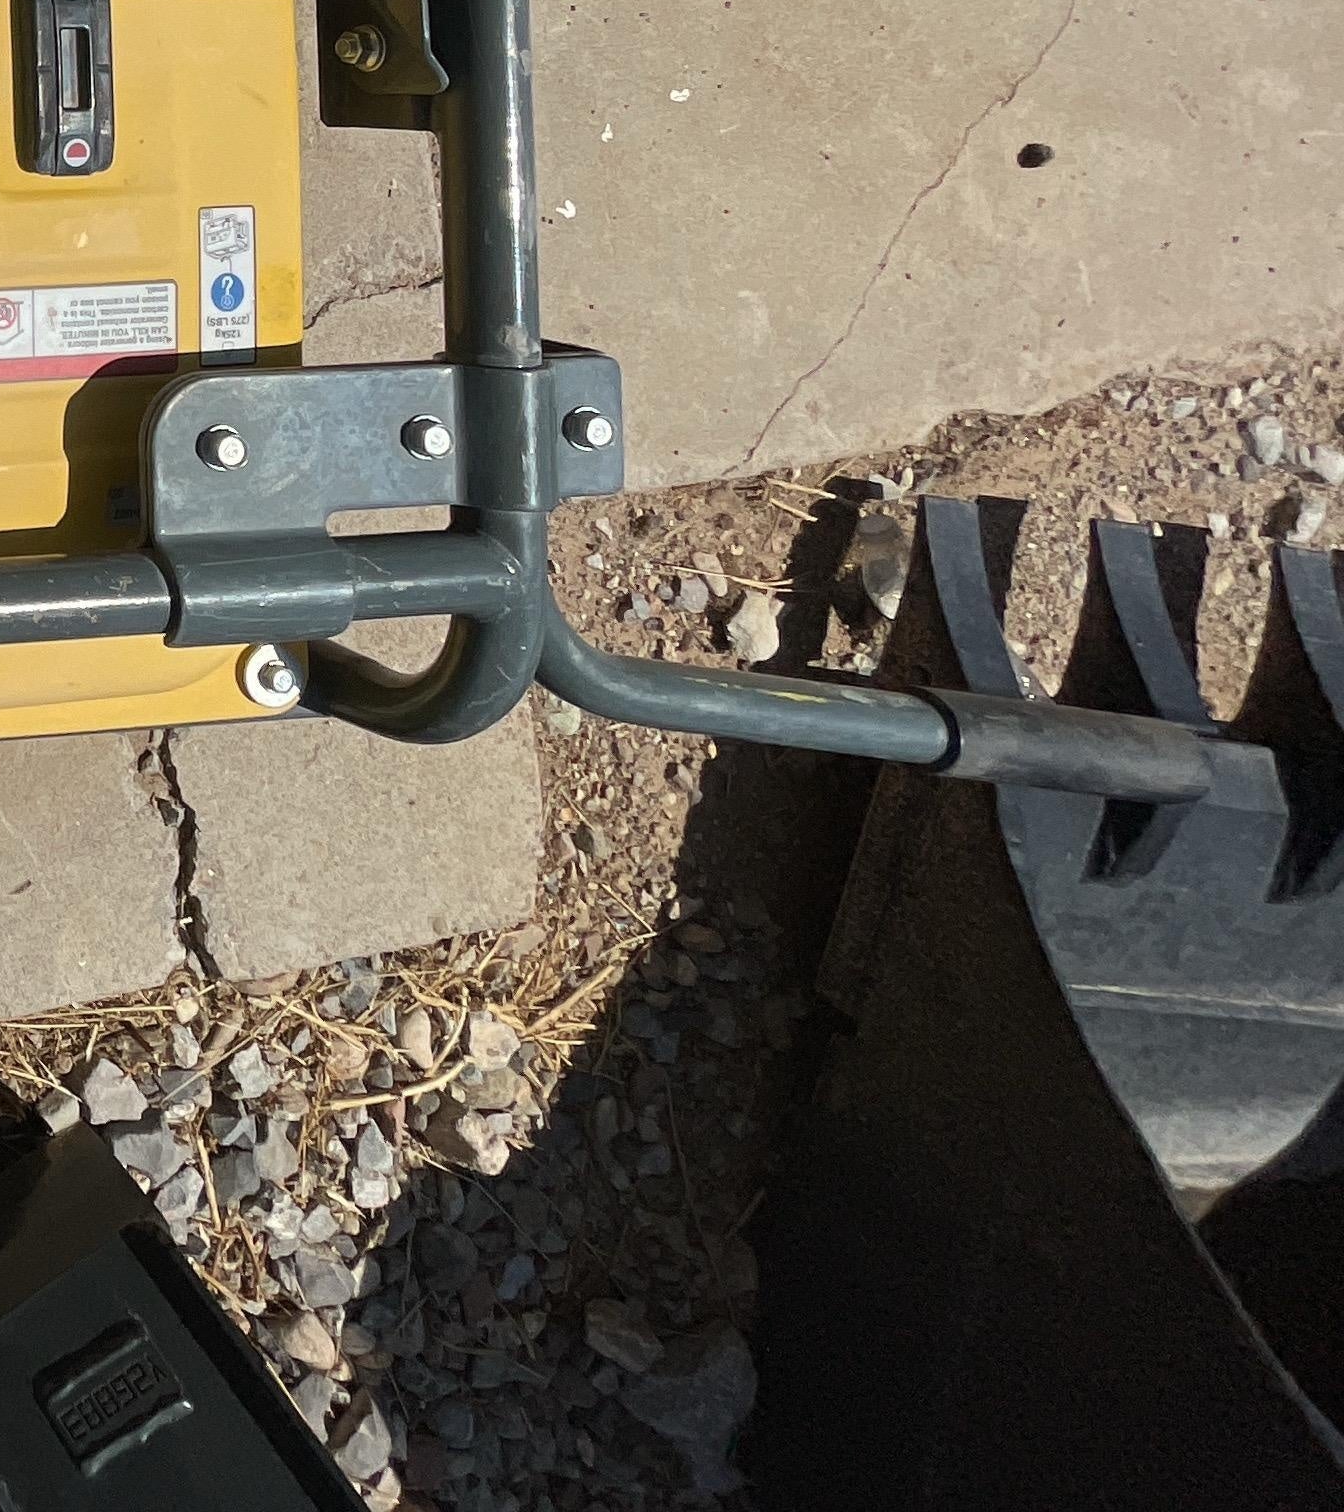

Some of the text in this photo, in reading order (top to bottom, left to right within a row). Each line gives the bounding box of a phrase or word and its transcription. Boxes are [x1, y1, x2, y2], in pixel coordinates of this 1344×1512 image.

[206, 316, 249, 326] (275 LBS)
[215, 329, 240, 338] 125kg
